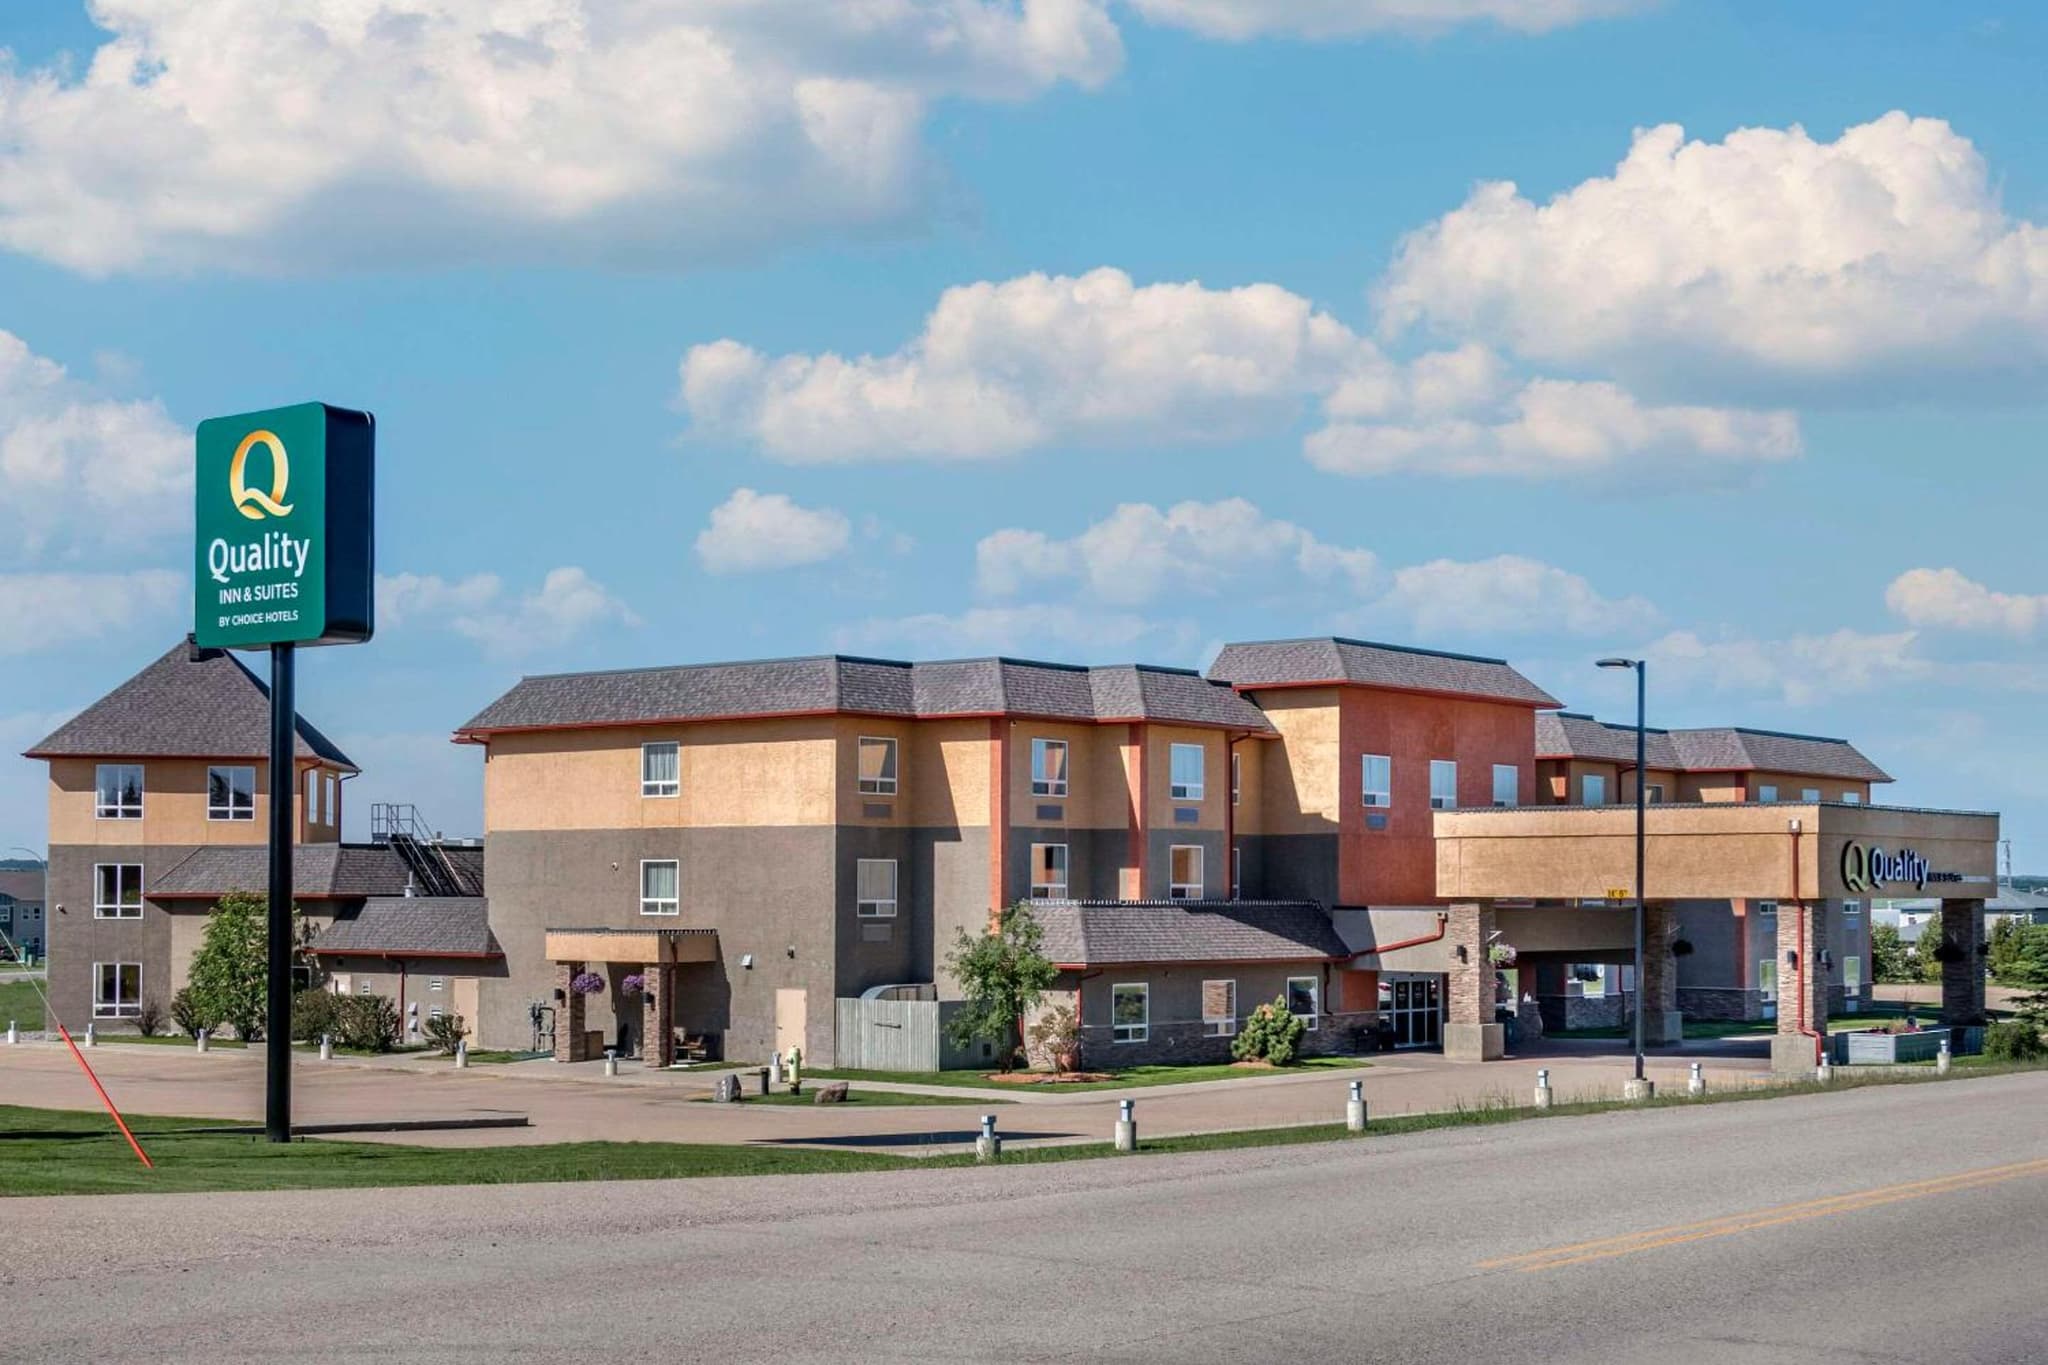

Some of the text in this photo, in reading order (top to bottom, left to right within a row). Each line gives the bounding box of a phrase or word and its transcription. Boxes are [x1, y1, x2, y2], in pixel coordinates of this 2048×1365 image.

[230, 429, 294, 520] Q
[208, 531, 310, 583] Quality
[219, 582, 298, 604] INN & SUITES
[219, 609, 299, 627] BY CHOICE HOTELS
[1870, 848, 1929, 891] Quality
